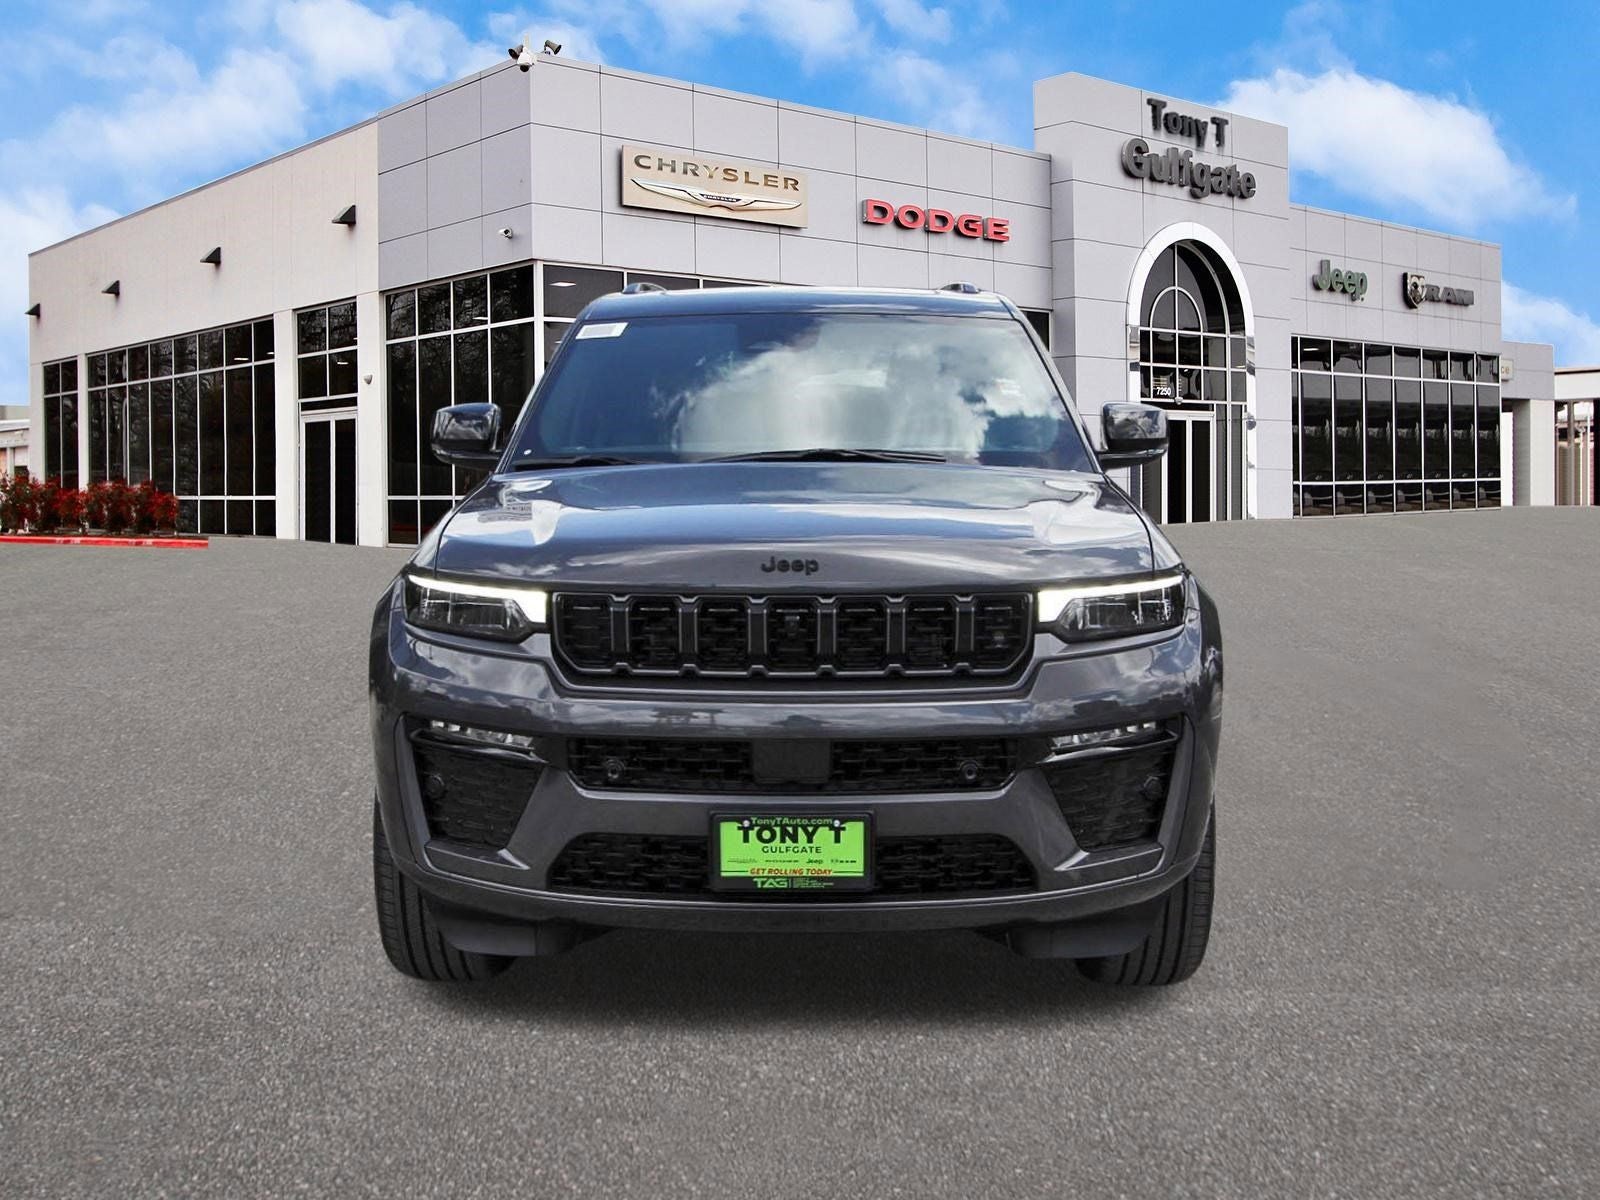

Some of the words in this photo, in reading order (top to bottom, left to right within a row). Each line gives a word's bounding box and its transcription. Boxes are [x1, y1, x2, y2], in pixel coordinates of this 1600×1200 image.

[1146, 98, 1208, 148] Tony
[1210, 116, 1229, 148] T
[633, 154, 800, 192] CHRYSLER
[1121, 138, 1256, 199] Gulfgate
[862, 198, 1010, 242] DODGE
[1312, 259, 1368, 302] Jeep
[1424, 283, 1475, 307] RAM
[1156, 386, 1172, 396] 7250
[761, 556, 819, 576] Jeep
[751, 817, 833, 826] TonyTAuto.com
[737, 825, 821, 844] TONY
[828, 825, 846, 844] T
[761, 846, 822, 854] GULFGATE
